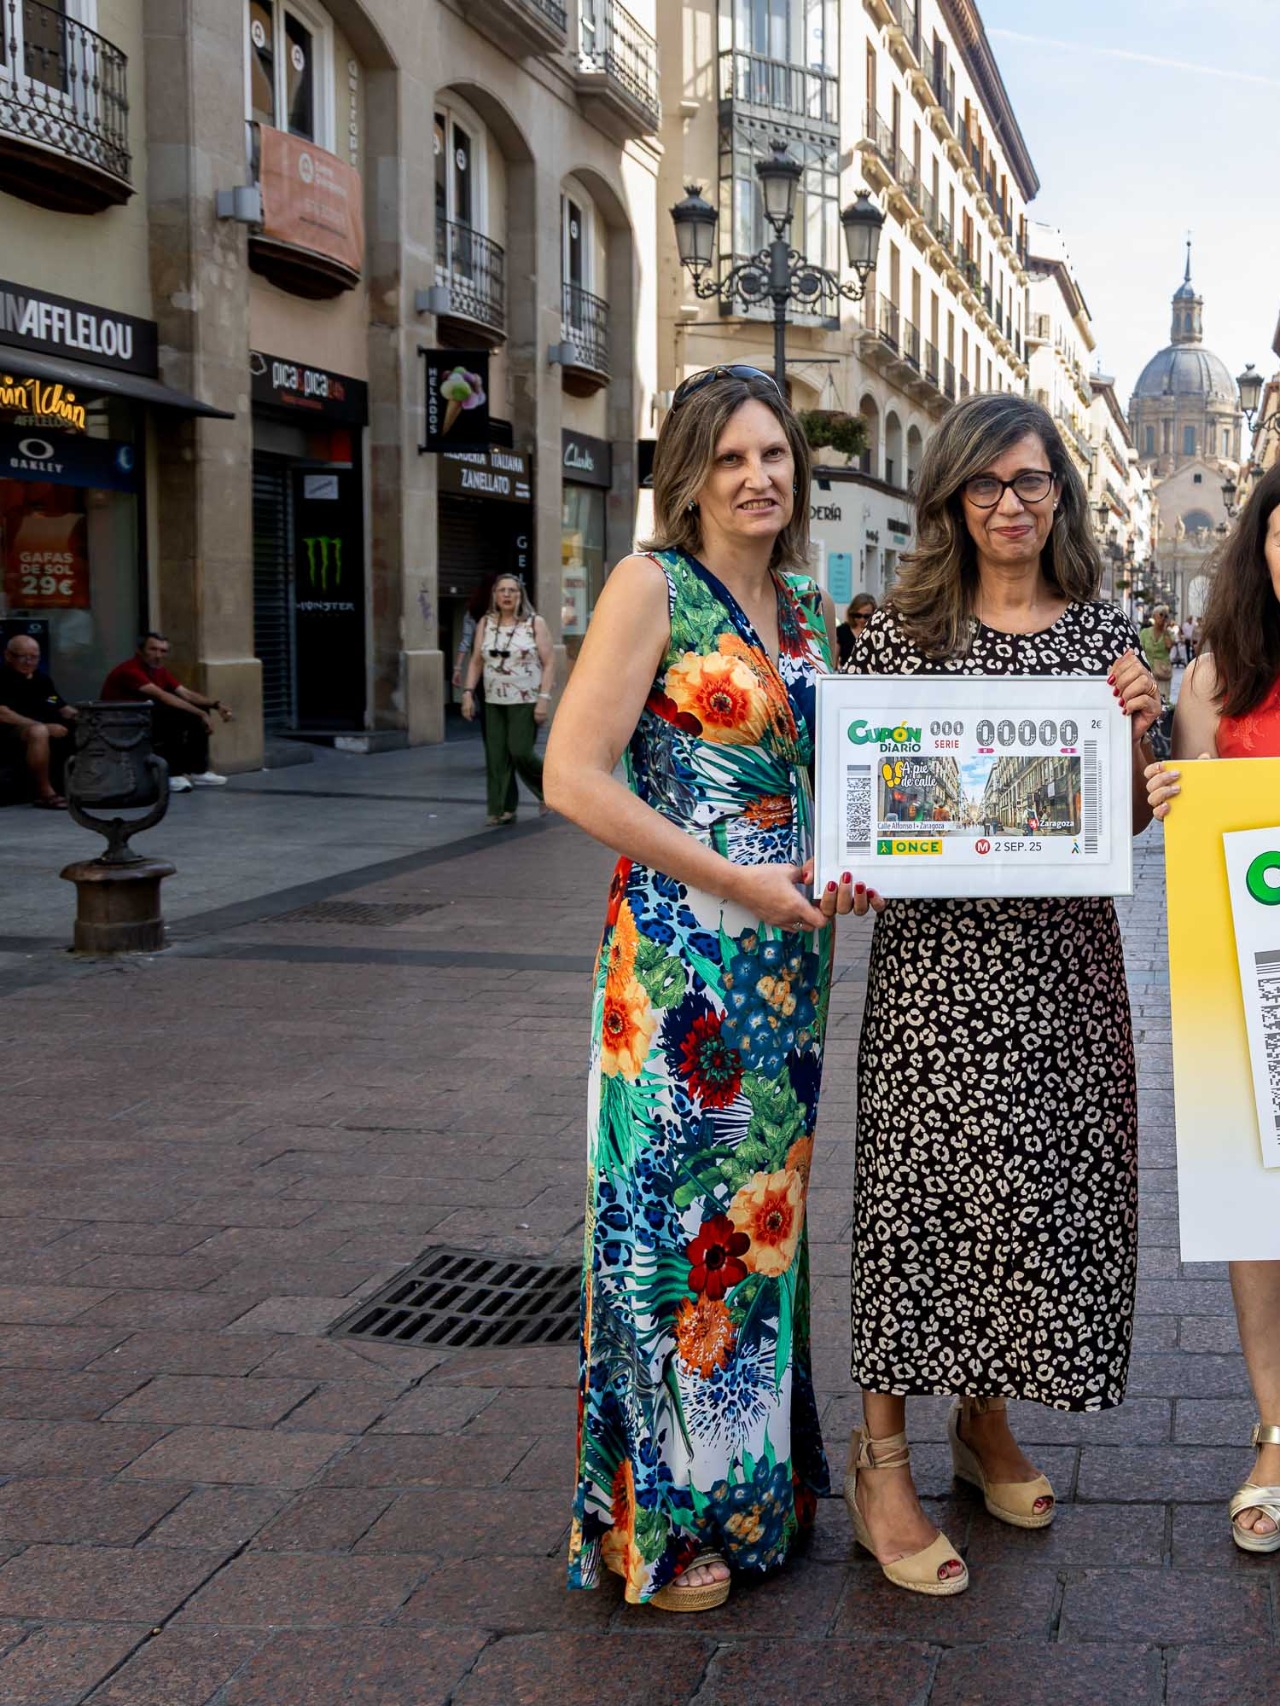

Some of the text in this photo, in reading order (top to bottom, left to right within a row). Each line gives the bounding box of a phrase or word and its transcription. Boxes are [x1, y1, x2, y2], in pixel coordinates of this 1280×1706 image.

[428, 367, 438, 435] HELADOS
[490, 452, 524, 474] ITALIANA
[563, 443, 594, 471] Clarks
[10, 457, 63, 473] OAKLEY
[461, 468, 510, 495] ZANELLATO
[19, 552, 74, 563] GAFAS
[20, 563, 74, 574] DE SOL
[21, 575, 75, 596] 29€
[847, 719, 1102, 746] CUPÓN 000 00000 2€
[934, 739, 960, 749] SERIE
[900, 761, 929, 778] A pie
[900, 777, 938, 788] de calle
[877, 822, 891, 830] Calle
[891, 822, 912, 830] Alfonso
[919, 822, 945, 831] Zaragoza
[1039, 819, 1075, 829] Zaragoza
[896, 841, 939, 852] ONCE
[994, 842, 1001, 852] 2
[1003, 842, 1028, 852] SEP.
[1029, 842, 1042, 852] 25
